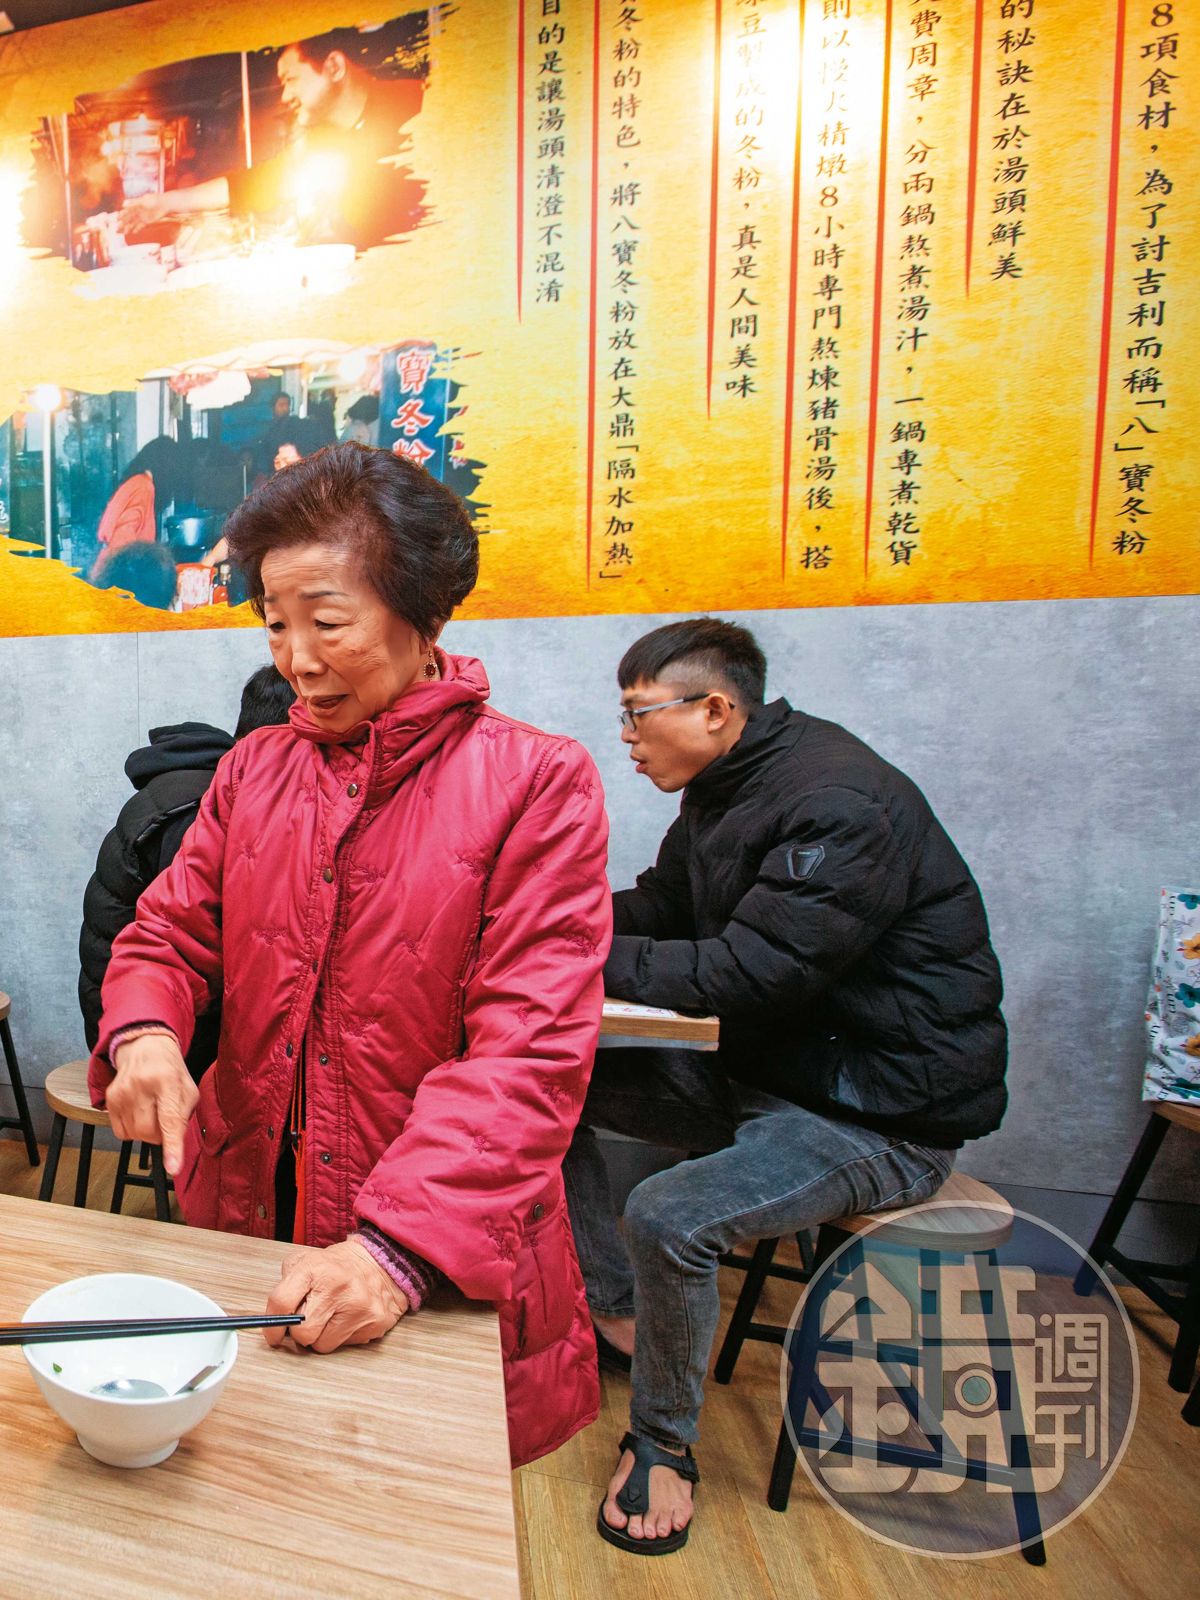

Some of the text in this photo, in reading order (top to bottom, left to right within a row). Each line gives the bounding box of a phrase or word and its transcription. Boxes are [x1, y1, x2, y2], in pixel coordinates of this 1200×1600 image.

[599, 0, 645, 580] 冬粉的特色，將八寶冬粉放在大鼎「隔水加熱」
[885, 0, 942, 567] 費周章，分兩鍋熬煮湯汁，一鍋專煮乾貨
